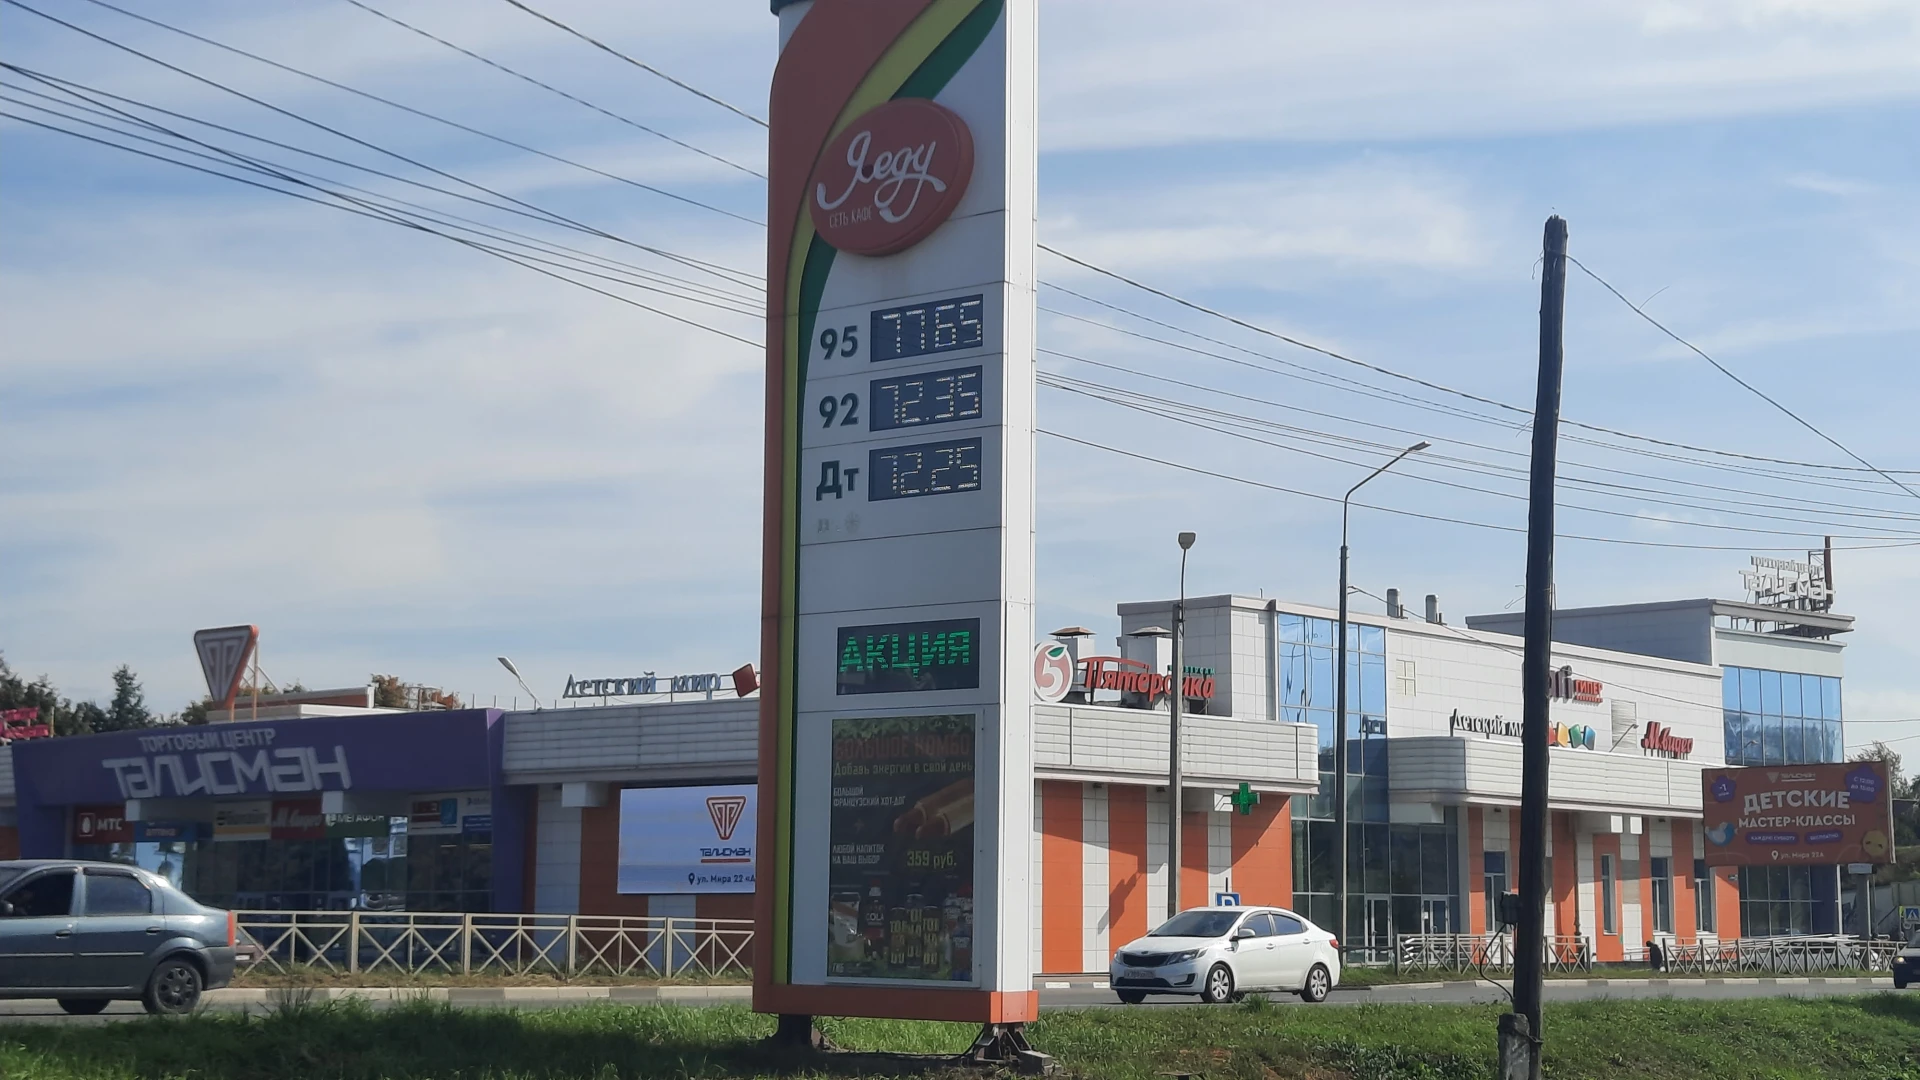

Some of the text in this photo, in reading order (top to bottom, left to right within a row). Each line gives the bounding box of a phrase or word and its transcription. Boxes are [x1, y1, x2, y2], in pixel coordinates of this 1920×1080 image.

[829, 205, 873, 228] СЕТЬ КАФЕ
[820, 325, 858, 360] 95
[819, 372, 979, 428] 92 72.35
[816, 446, 978, 501] Дт 72.25
[839, 631, 970, 678] АКЦИЯ
[562, 670, 721, 700] Детский мир
[1574, 678, 1602, 696] ГИПЕР
[1451, 708, 1505, 736] Детский
[138, 727, 276, 752] ТОРГОВЫЙ ЦЕНТР
[834, 732, 970, 761] БОЛЬШОЕ КОМБО
[833, 759, 973, 776] Добавь энергии в свой день
[833, 785, 863, 796] БОЛЬШОЙ
[833, 796, 905, 807] ФРАНЦУЗСКИЙ ХОТ-ДОГ
[1743, 790, 1851, 815] ДЕТСКИЕ
[96, 817, 123, 831] МТС
[1738, 814, 1856, 829] МАСТЕР-КЛАССЫ
[832, 843, 884, 854] ЛЮБОЙ НАПИТОК
[832, 854, 880, 864] НА ВАШ ВЫБОР
[907, 849, 957, 869] 359 руб.
[697, 875, 708, 885] ул.
[711, 874, 731, 884] Мира
[734, 874, 743, 882] 22
